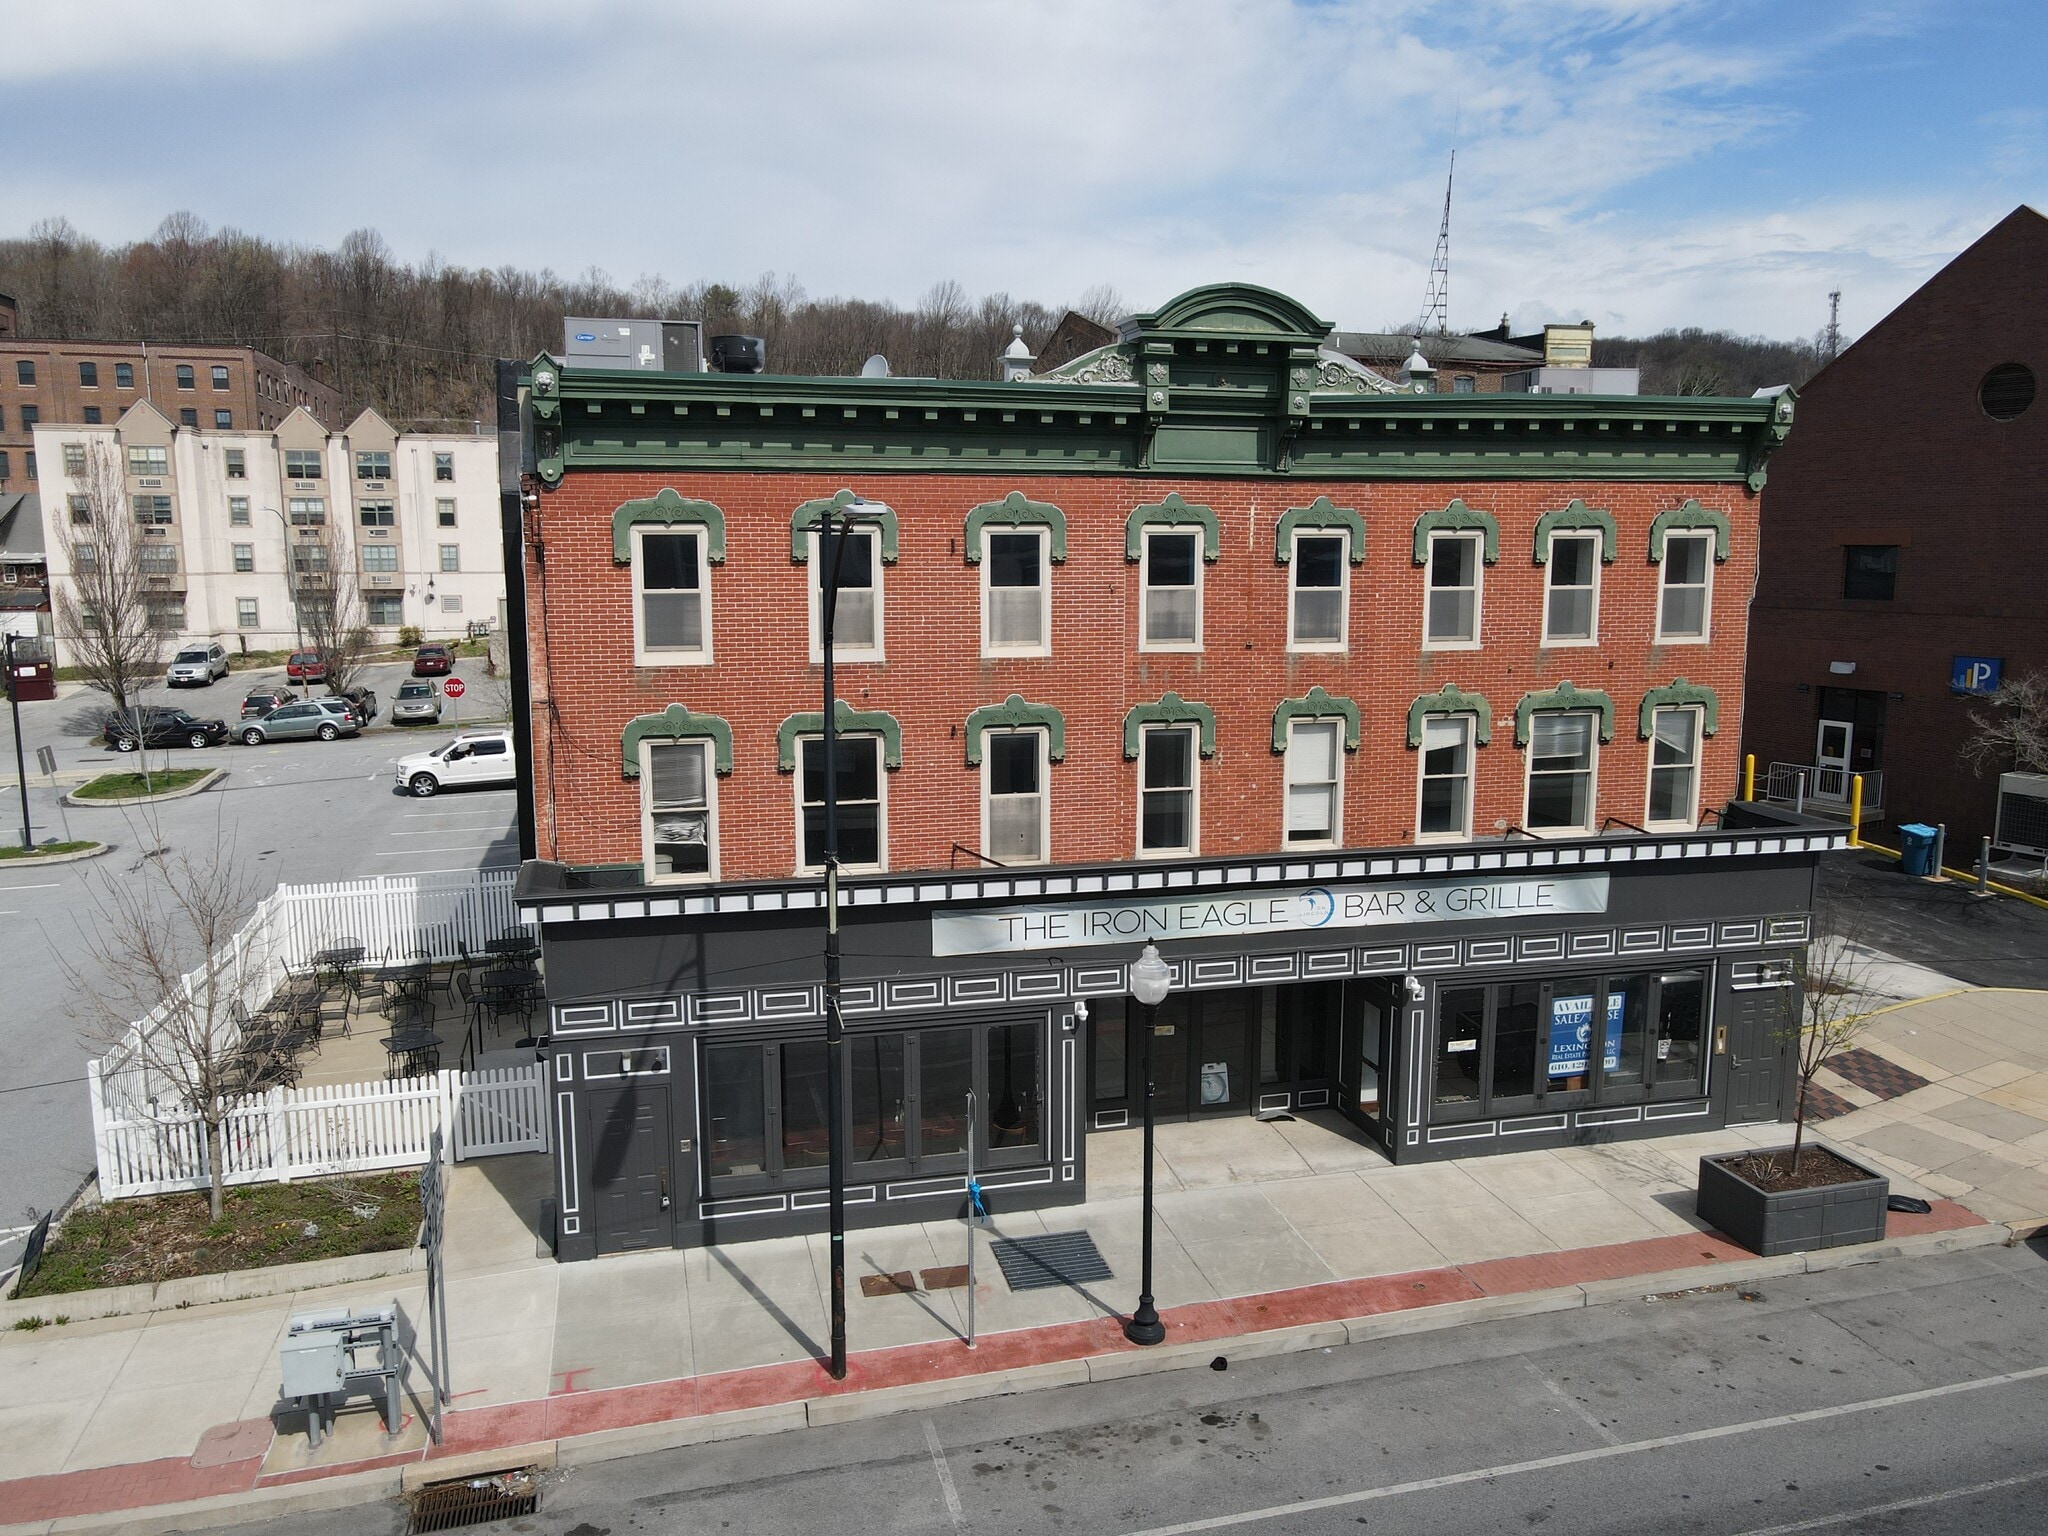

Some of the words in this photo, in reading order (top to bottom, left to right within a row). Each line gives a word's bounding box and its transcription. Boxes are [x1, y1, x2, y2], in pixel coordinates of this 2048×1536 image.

[445, 683, 464, 692] STOP
[998, 913, 1069, 942] THE
[1083, 907, 1168, 937] IRON
[1179, 899, 1289, 930] EAGLE
[1345, 892, 1405, 918] BAR
[1414, 889, 1436, 913] &
[1446, 884, 1555, 912] GRILLE
[1557, 997, 1619, 1012] AVAILE
[1554, 1010, 1619, 1025] SALE/SE
[1554, 1040, 1615, 1053] LEXINN
